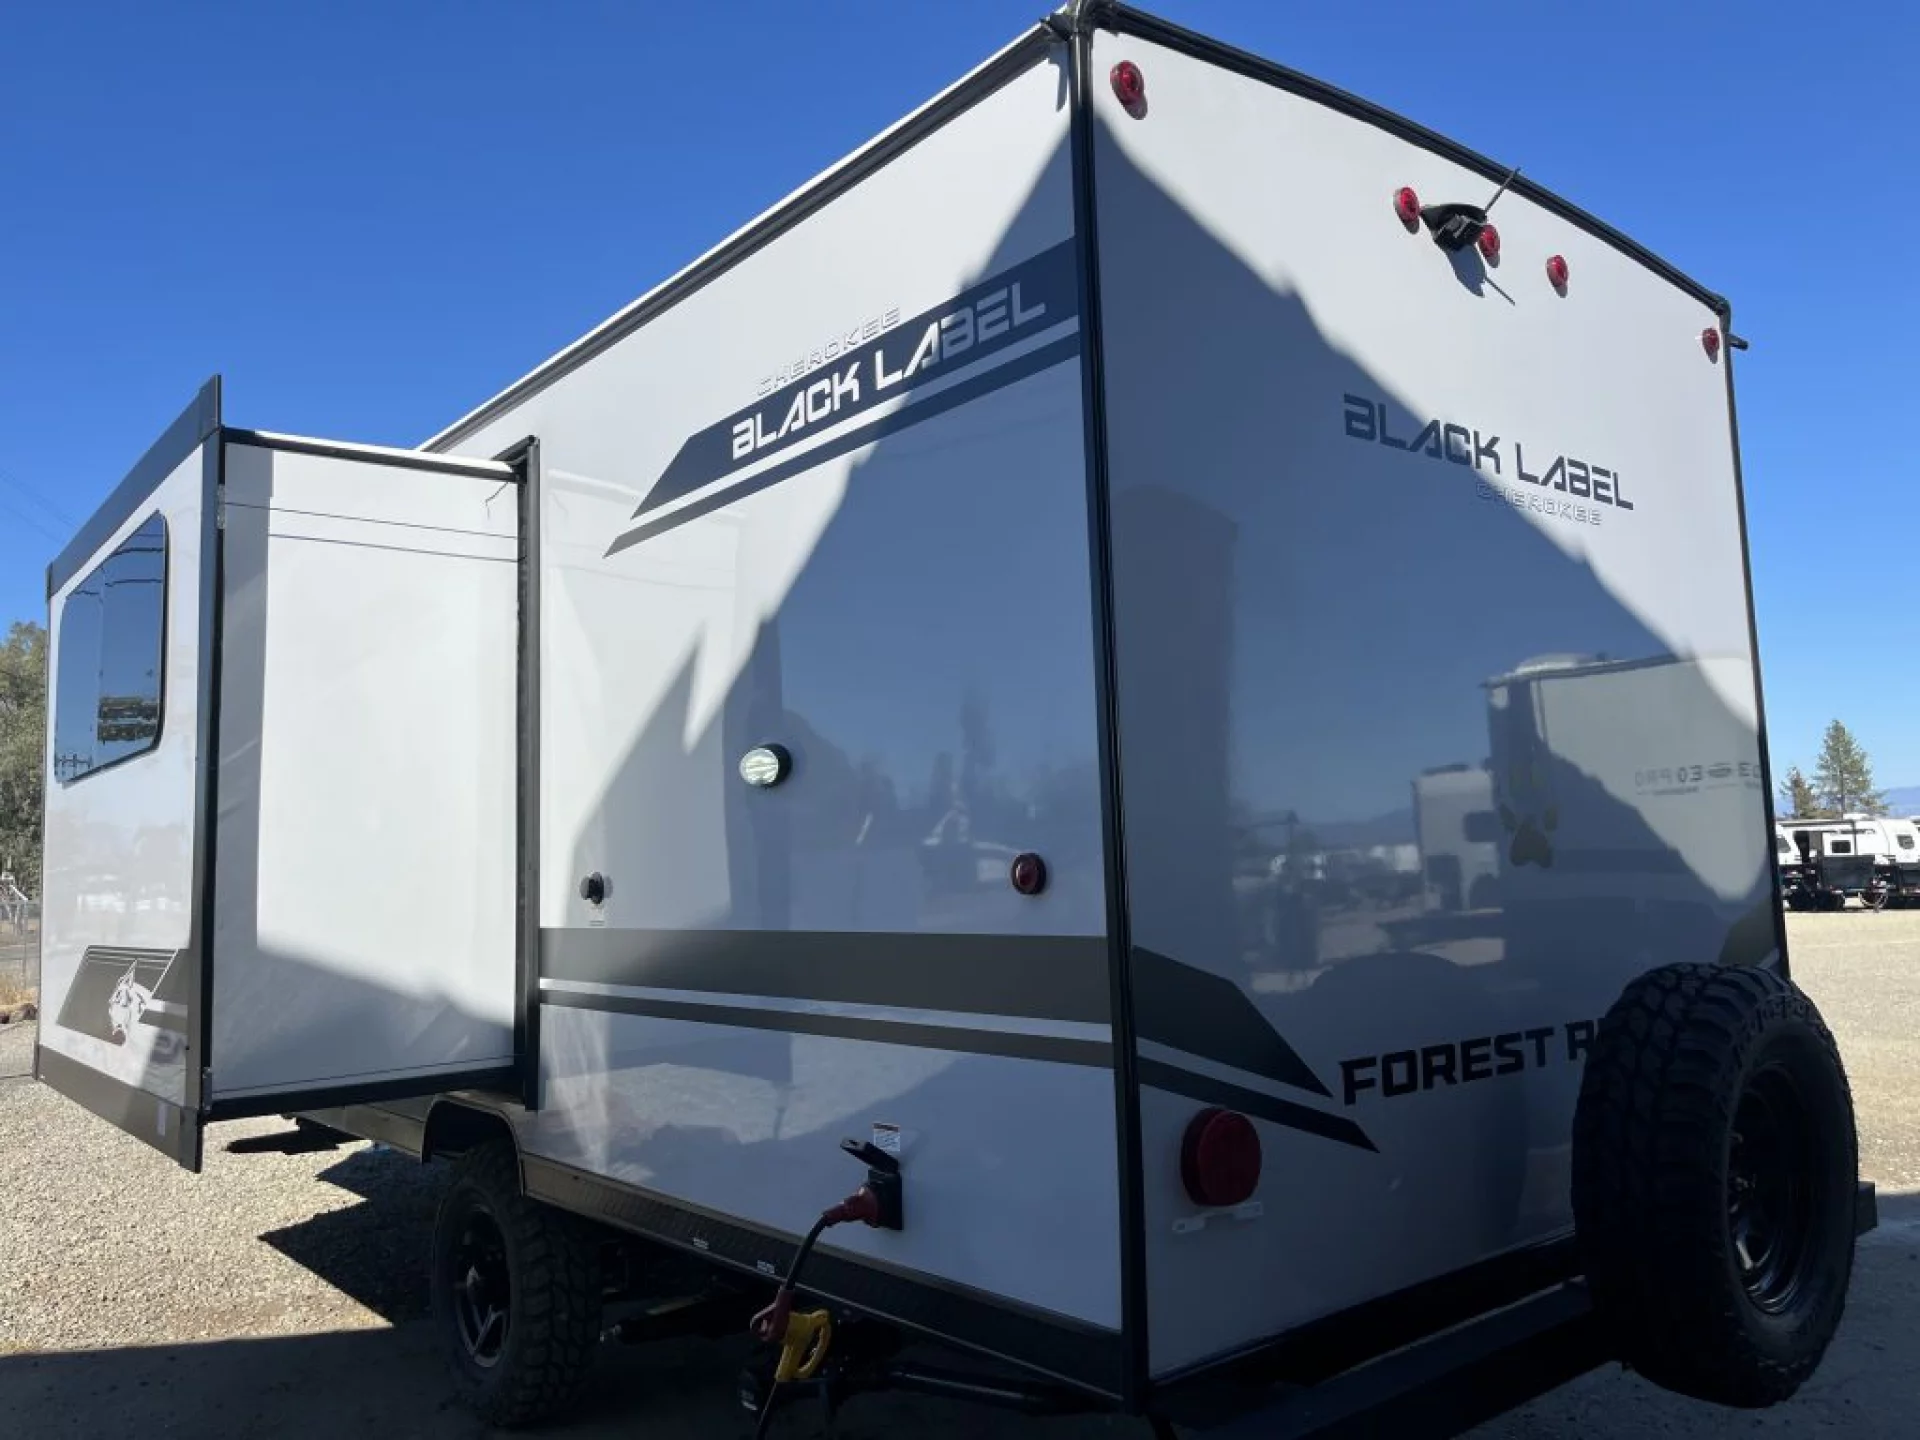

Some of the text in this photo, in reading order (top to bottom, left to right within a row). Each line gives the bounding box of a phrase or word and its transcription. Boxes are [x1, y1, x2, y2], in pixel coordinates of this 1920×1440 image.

[732, 281, 1046, 460] BLACK LABEL
[755, 306, 902, 396] CHEROKEE
[1343, 393, 1634, 511] BLACK LABEL
[1475, 481, 1603, 526] CHEROKEE
[1339, 1026, 1555, 1105] FOREST
